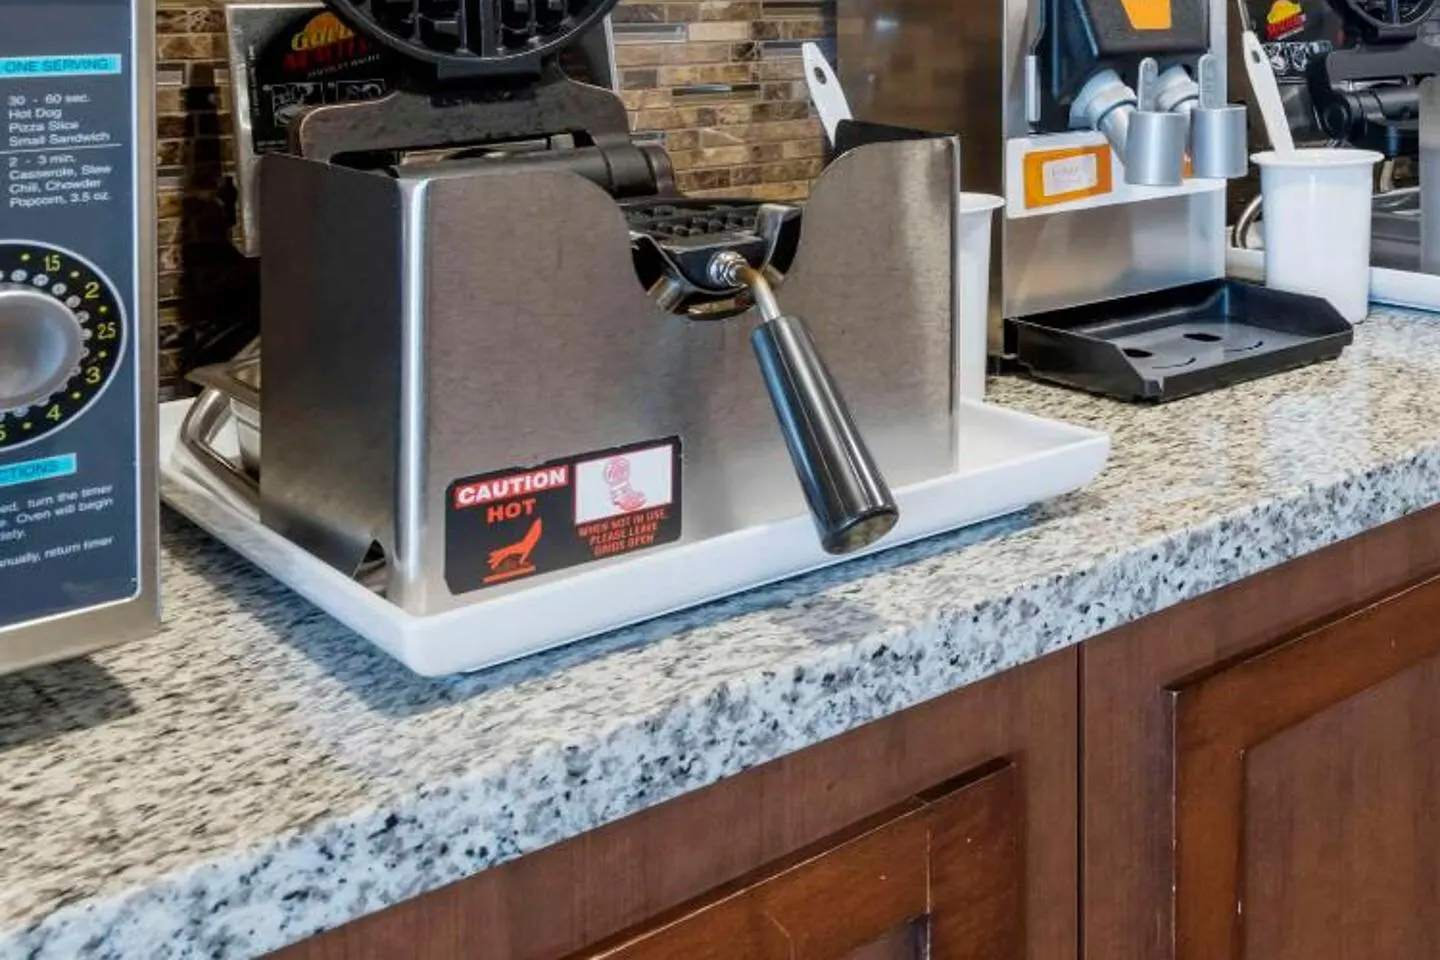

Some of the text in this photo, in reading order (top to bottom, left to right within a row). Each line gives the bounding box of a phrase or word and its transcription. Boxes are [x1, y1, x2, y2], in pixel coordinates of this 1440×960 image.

[4, 57, 110, 74] ONE SERVING
[8, 108, 62, 120] Hot Dog
[8, 122, 45, 133] Pizza
[9, 132, 110, 147] Small Sandwich
[84, 281, 100, 299] 2
[85, 366, 101, 384] 3
[46, 404, 62, 421] 4
[457, 466, 567, 505] CAUTION
[16, 509, 51, 525] Oven
[487, 498, 537, 524] HOT
[589, 527, 627, 545] PLEASE
